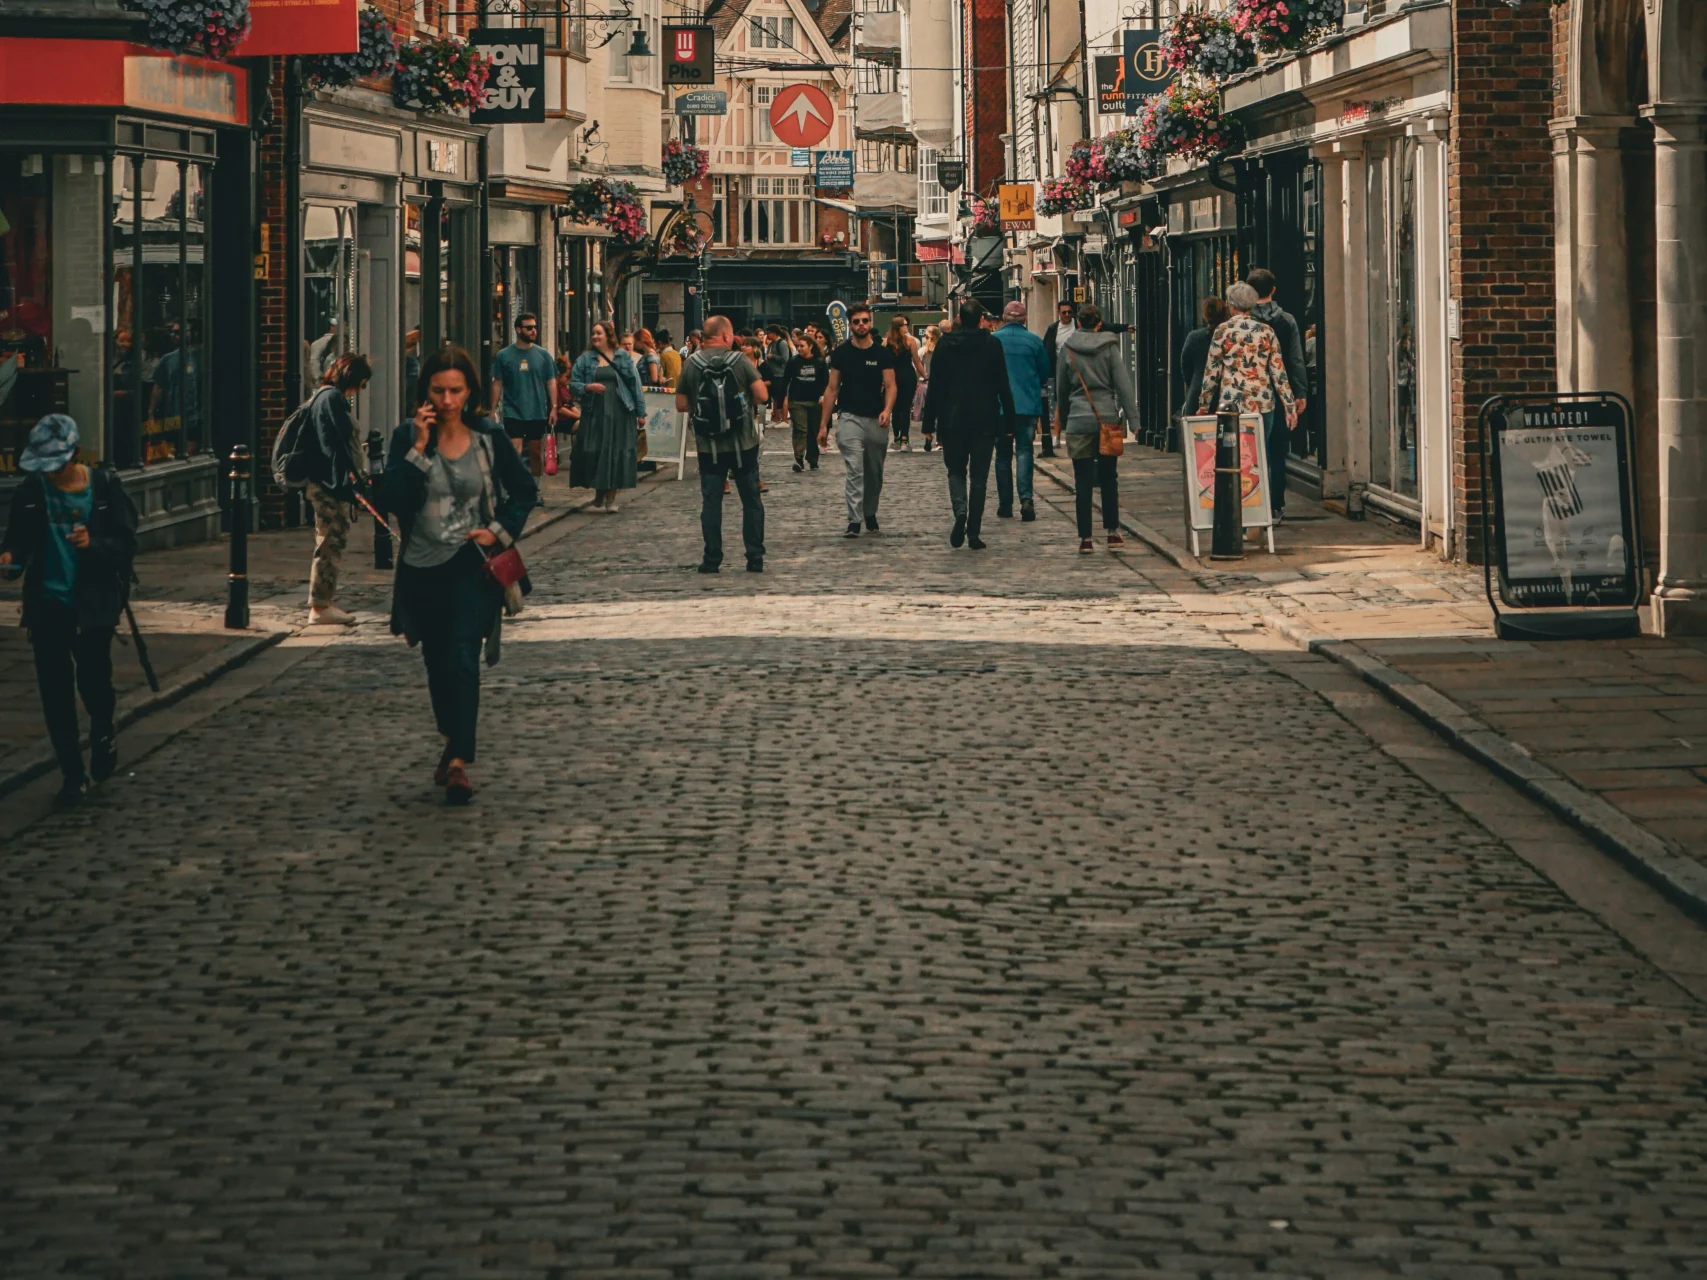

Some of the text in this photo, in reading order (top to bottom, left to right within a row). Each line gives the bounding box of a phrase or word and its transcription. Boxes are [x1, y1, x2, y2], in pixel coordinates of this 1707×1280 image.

[476, 44, 538, 65] TONI
[496, 66, 521, 87] &
[668, 64, 702, 78] Pho
[478, 87, 536, 110] GUY
[686, 93, 716, 102] Cradick
[1102, 92, 1125, 100] runn
[1102, 101, 1126, 110] outle
[1005, 221, 1031, 230] EWM
[1076, 289, 1083, 300] H
[832, 318, 844, 343] COFFE
[1524, 411, 1588, 426] WRAPPED!
[1524, 434, 1572, 444] ULTIMATE
[1577, 433, 1612, 442] TOWEL
